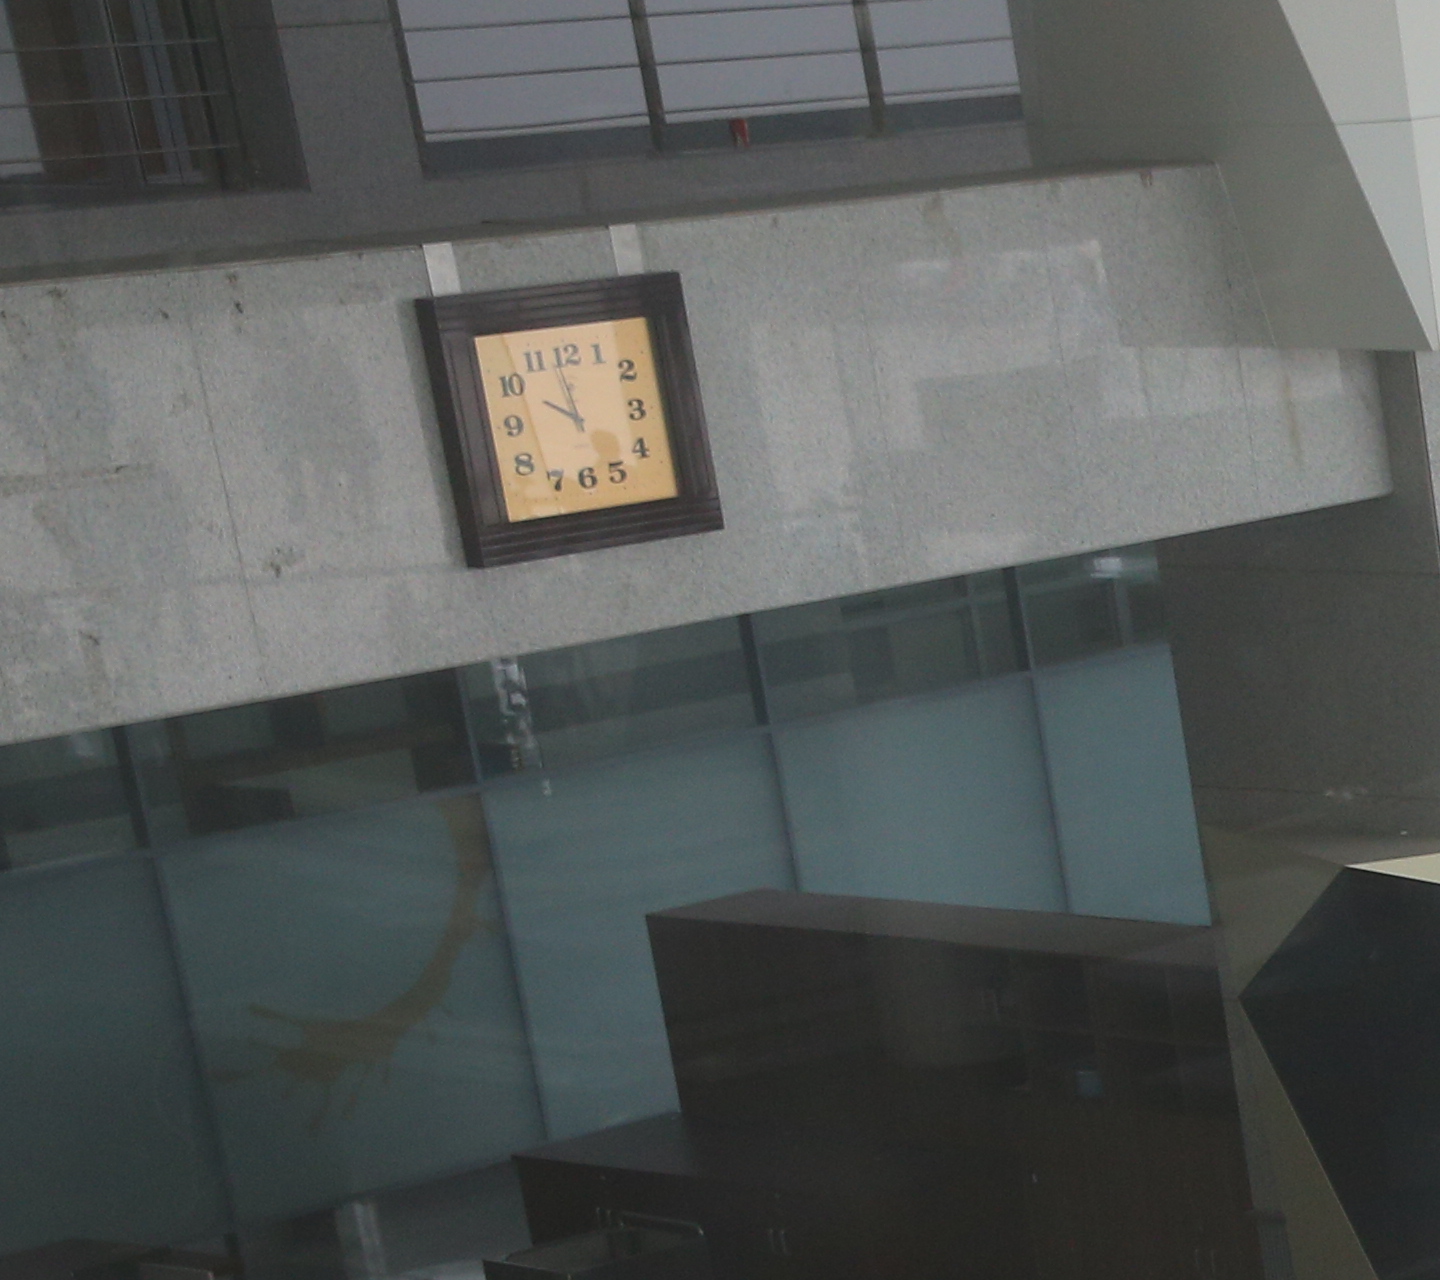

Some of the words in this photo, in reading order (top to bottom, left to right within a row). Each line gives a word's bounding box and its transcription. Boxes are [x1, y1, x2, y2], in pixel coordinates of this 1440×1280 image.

[523, 351, 547, 372] 11
[552, 343, 582, 367] 12
[591, 344, 606, 365] 1
[617, 359, 638, 381] 2
[499, 373, 526, 398] 10
[628, 399, 647, 420] 3
[504, 415, 524, 437] 9
[632, 438, 650, 458] 4
[515, 453, 535, 476] 8
[609, 461, 628, 484] 5
[546, 470, 564, 491] 7
[578, 467, 598, 489] 6
